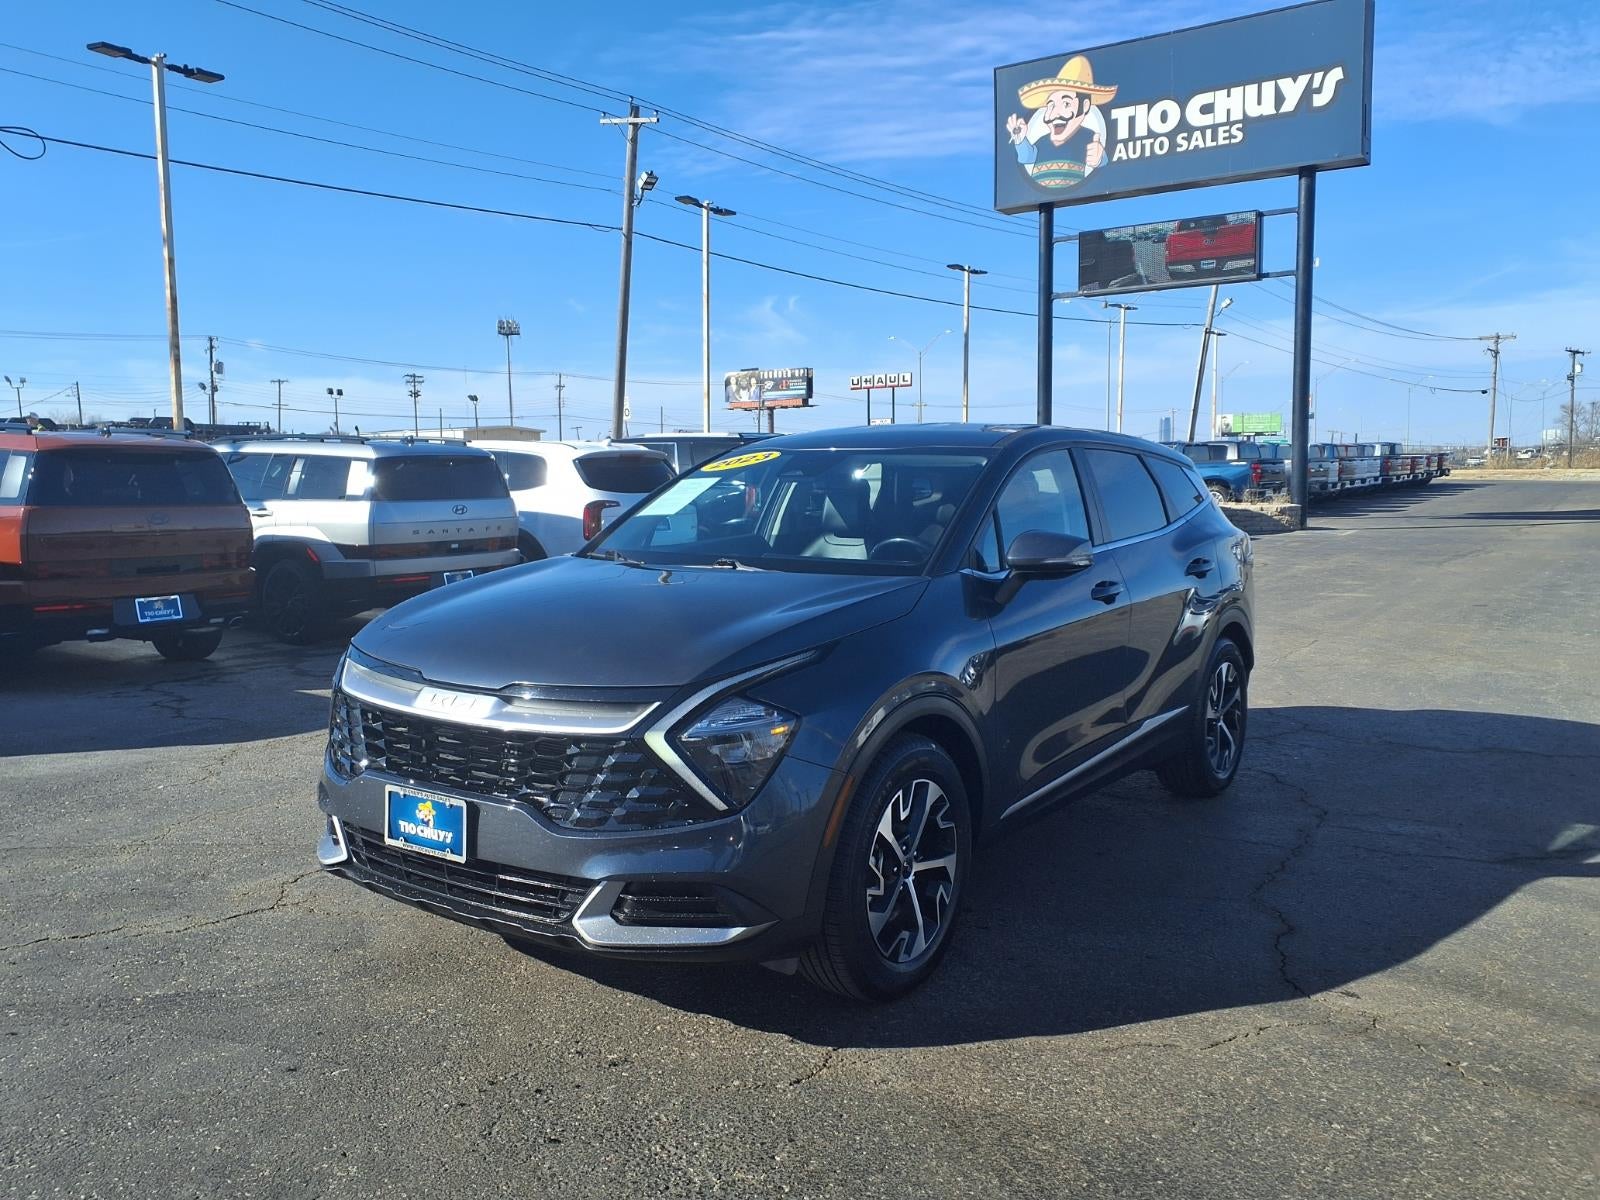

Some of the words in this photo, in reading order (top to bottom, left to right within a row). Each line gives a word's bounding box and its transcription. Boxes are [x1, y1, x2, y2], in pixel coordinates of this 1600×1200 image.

[1111, 99, 1182, 140] TIO
[1185, 66, 1344, 127] CHUY'S
[1112, 136, 1170, 162] AUTO
[1176, 123, 1244, 152] SALES
[412, 527, 475, 536] SANTA
[398, 819, 417, 835] TIO
[416, 824, 453, 844] CHUY'S
